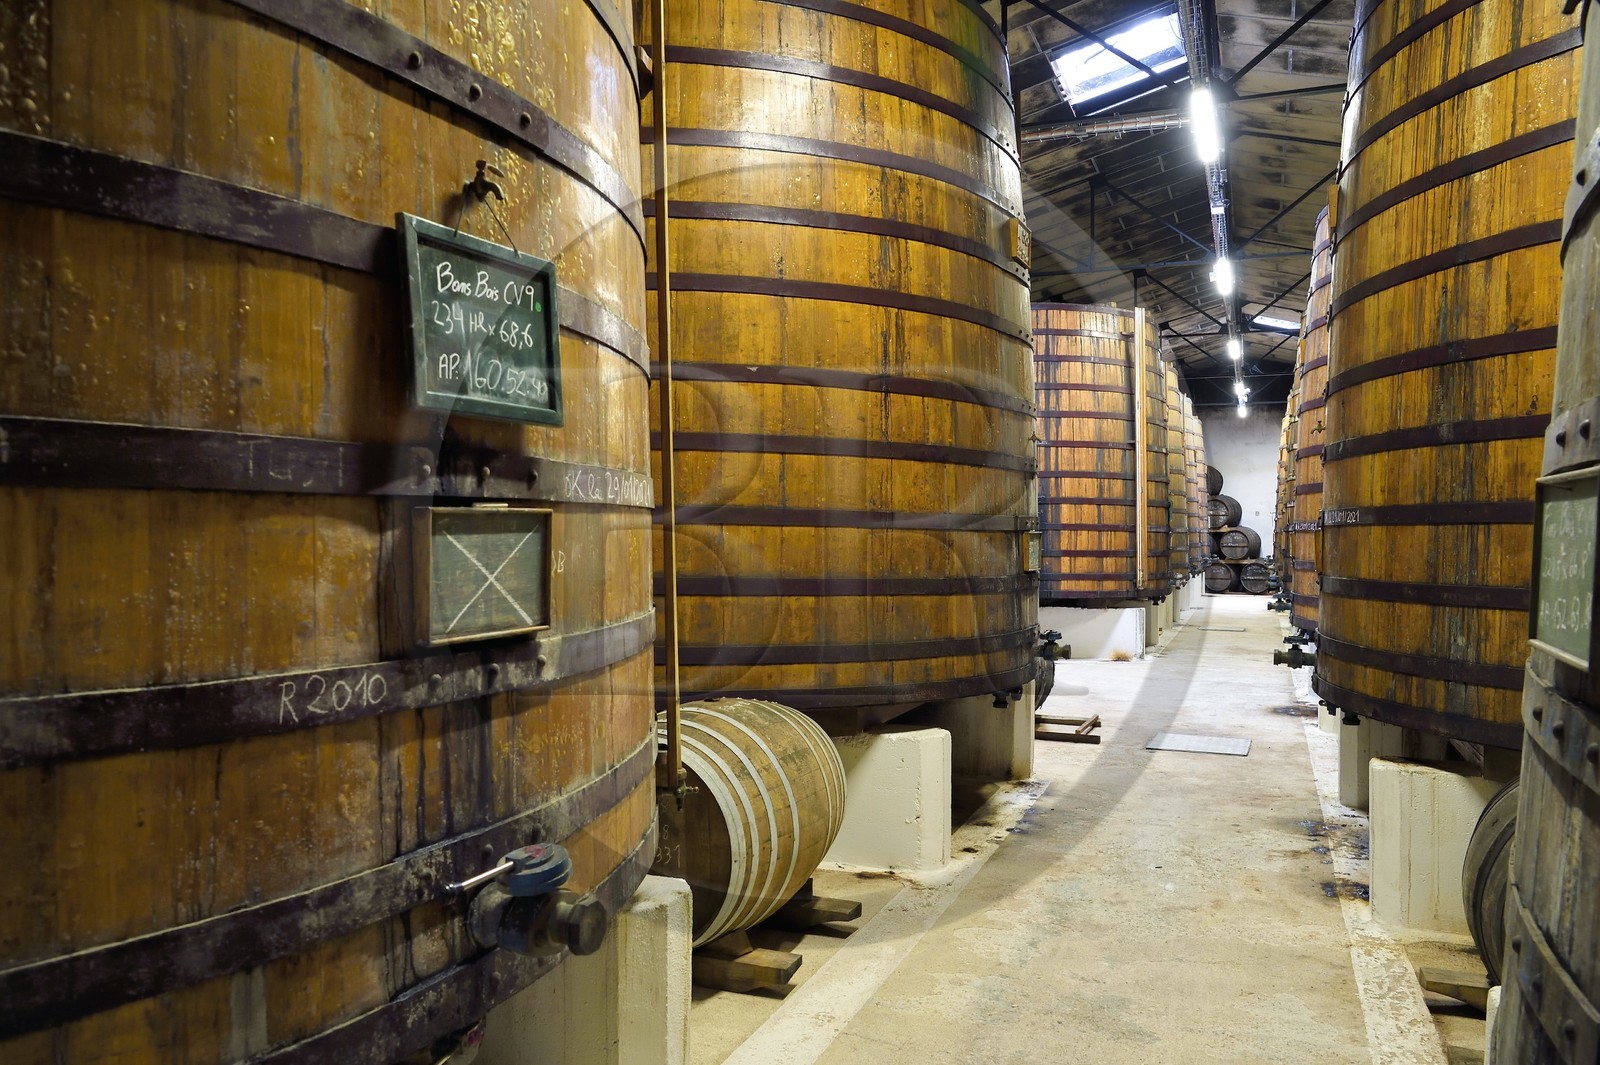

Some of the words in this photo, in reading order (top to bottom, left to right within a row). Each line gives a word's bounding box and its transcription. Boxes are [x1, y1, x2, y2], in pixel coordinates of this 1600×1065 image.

[436, 261, 472, 296] Bons
[474, 270, 500, 302] Bois
[503, 281, 535, 311] CV9
[431, 300, 465, 334] 234
[499, 319, 534, 350] 68,6
[279, 681, 299, 725] R
[305, 672, 387, 714] 2010
